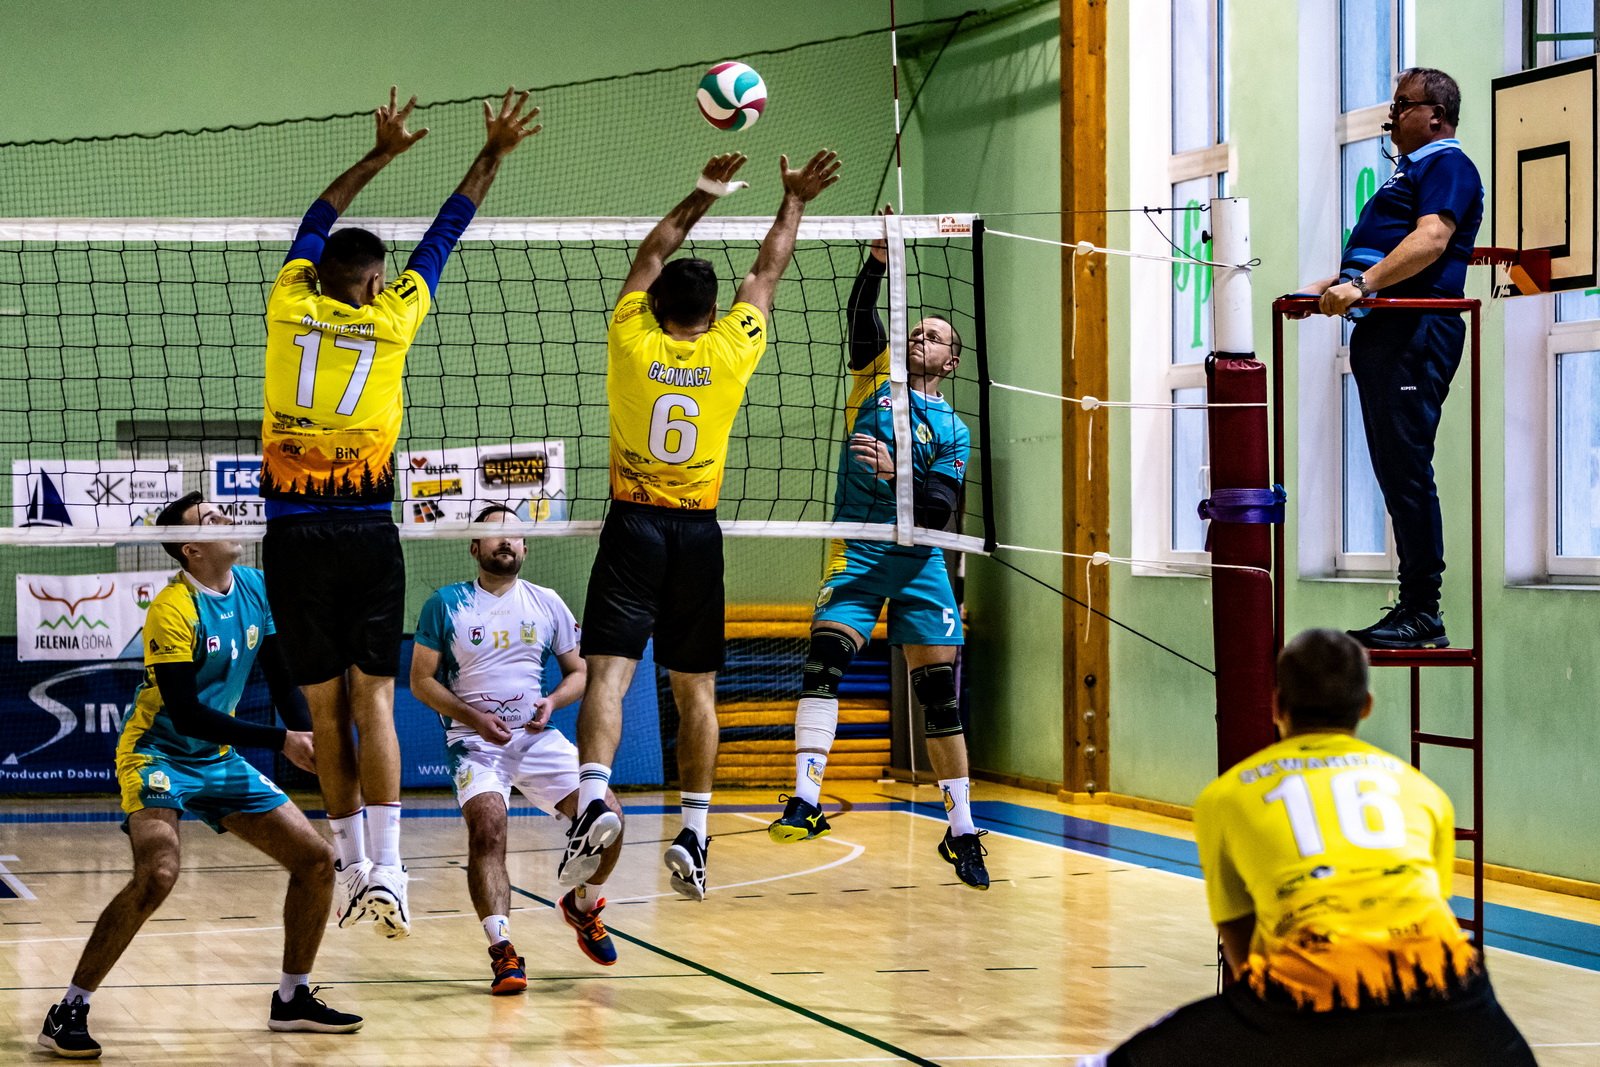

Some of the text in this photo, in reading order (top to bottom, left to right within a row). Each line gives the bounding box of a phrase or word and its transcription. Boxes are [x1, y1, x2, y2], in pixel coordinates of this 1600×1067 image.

[293, 329, 377, 416] 17
[648, 361, 712, 387] GŁOWACZ
[648, 392, 700, 465] 6
[129, 481, 157, 489] NEW
[129, 491, 178, 499] DESIGN
[942, 607, 956, 637] 5
[34, 633, 113, 650] JELENIA GÓRA
[492, 630, 511, 650] 13
[0, 769, 63, 779] Producent
[67, 768, 111, 780] Dobrej
[1264, 771, 1406, 858] 16
